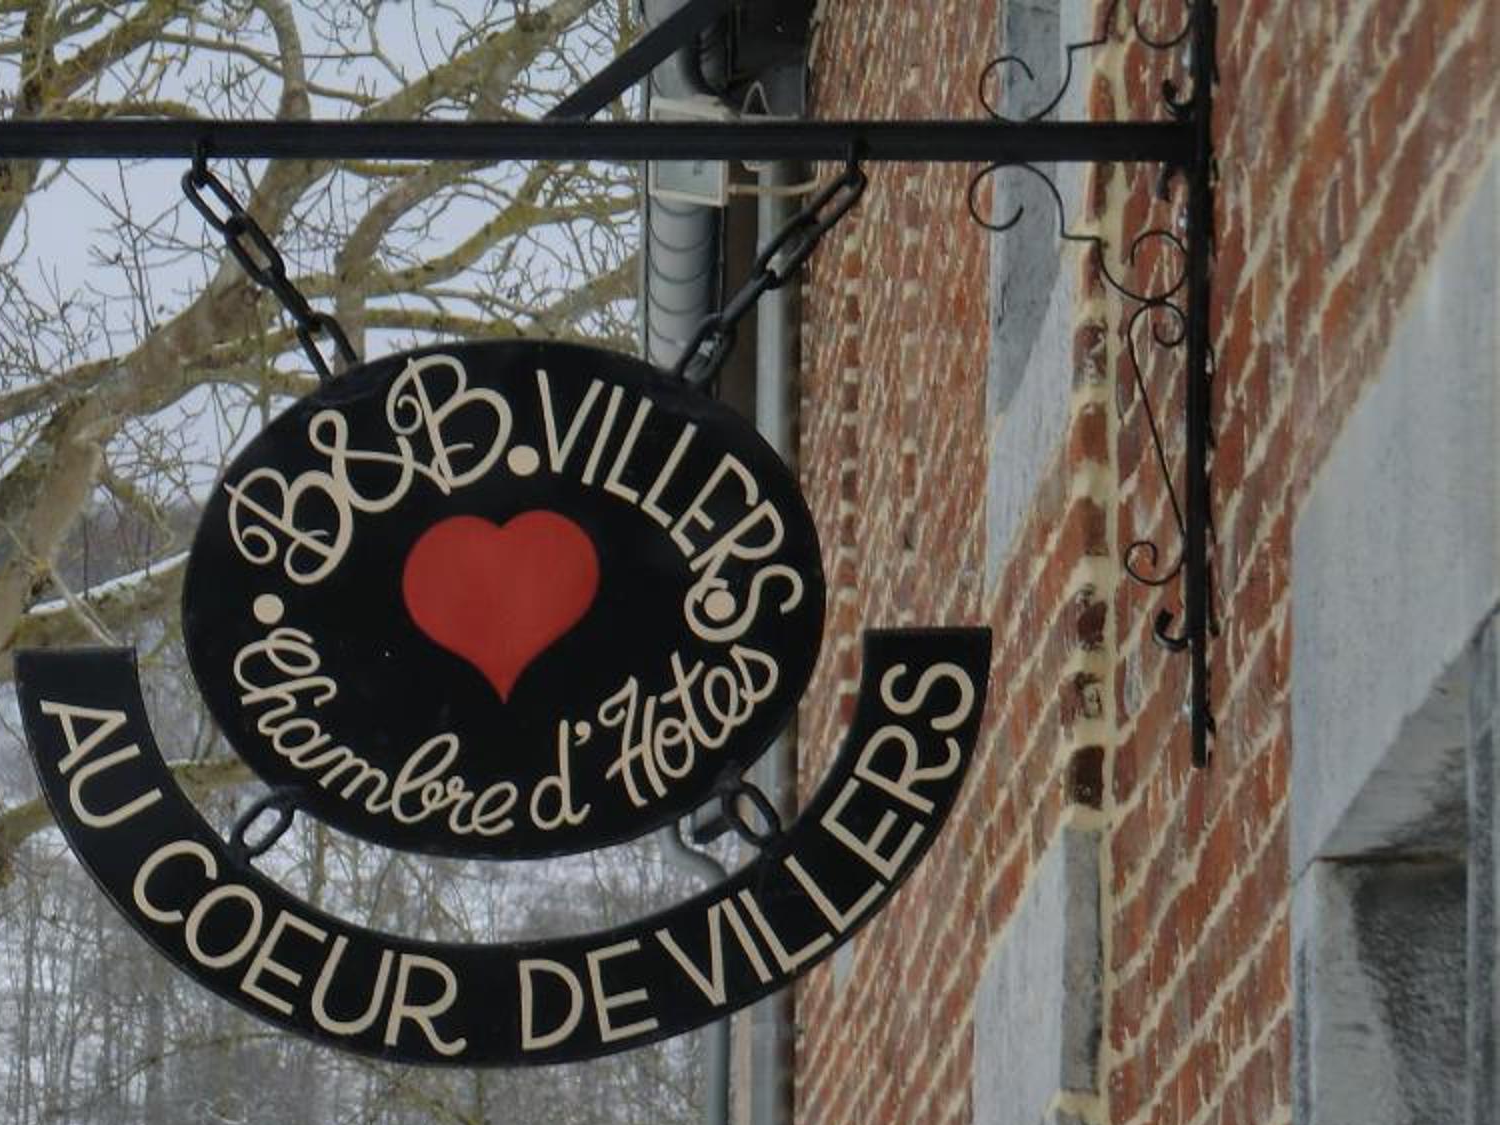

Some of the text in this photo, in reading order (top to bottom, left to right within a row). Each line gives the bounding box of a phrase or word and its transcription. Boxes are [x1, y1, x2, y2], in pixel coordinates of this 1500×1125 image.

[536, 369, 803, 642] VILLERS
[39, 663, 975, 1055] AU COEUR DE VILLERS
[233, 627, 518, 836] Chambre
